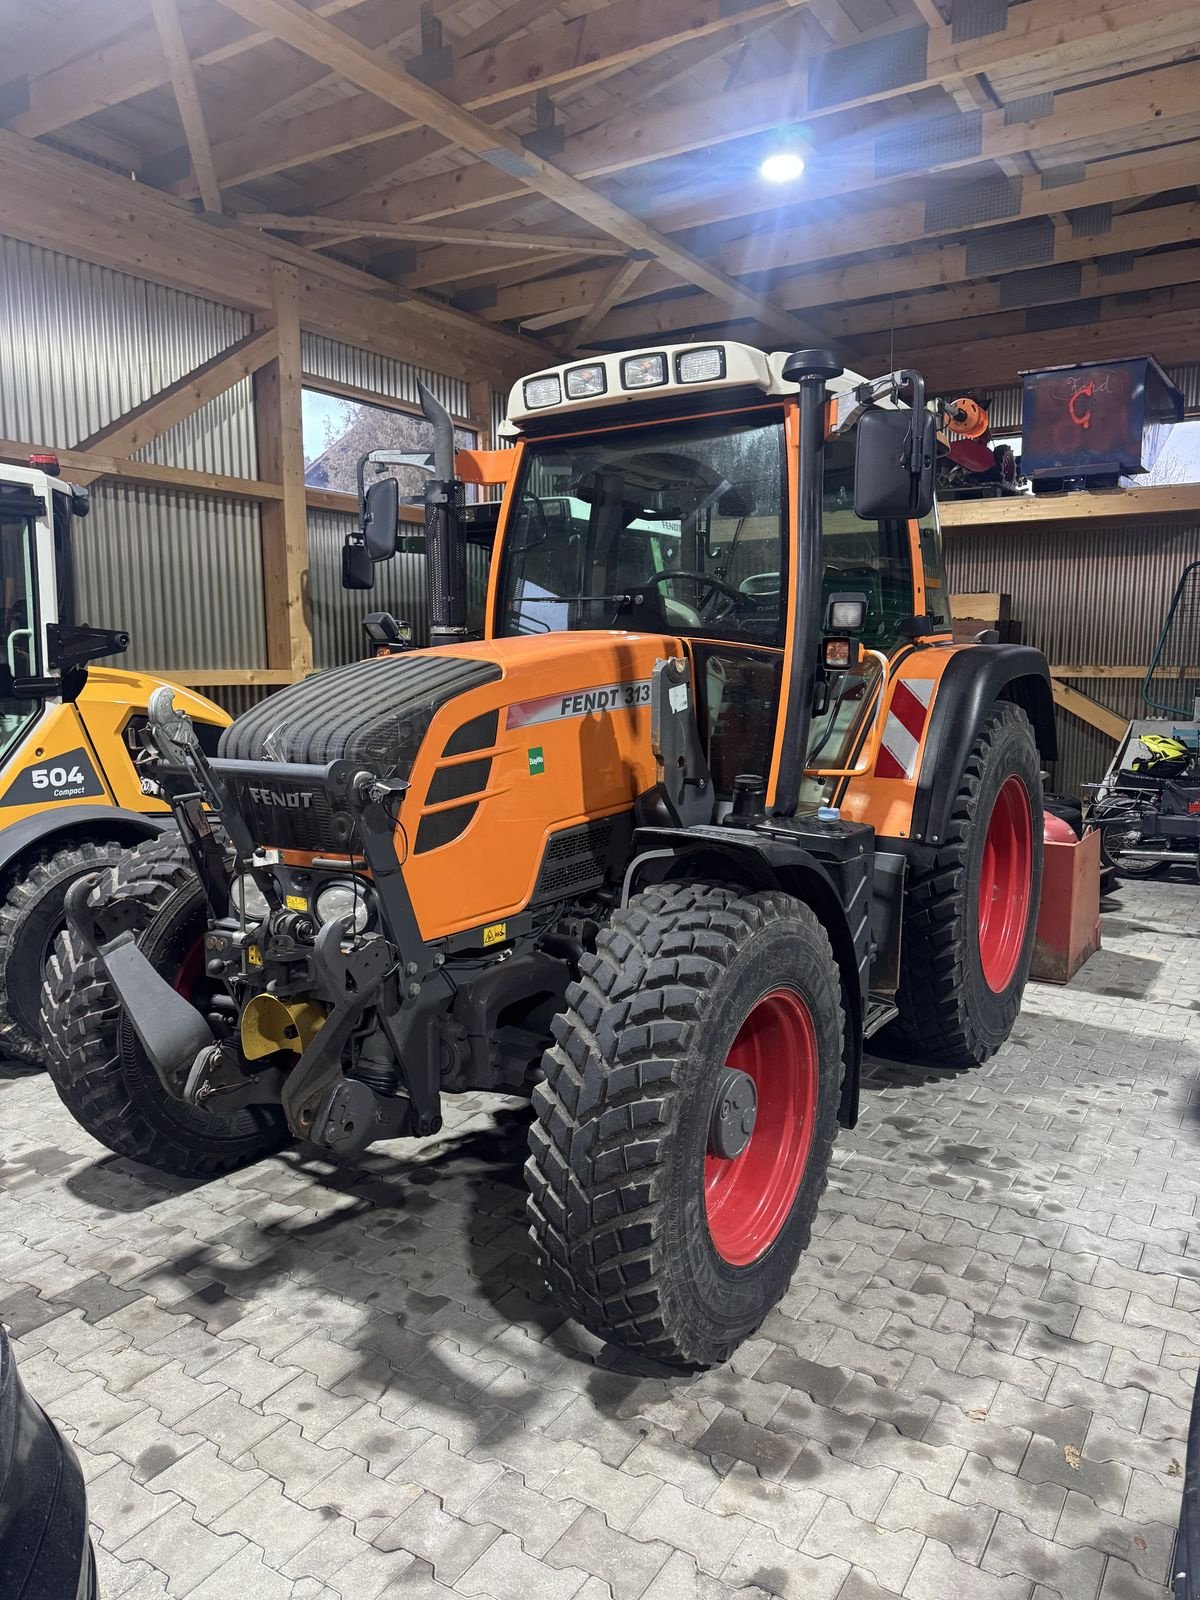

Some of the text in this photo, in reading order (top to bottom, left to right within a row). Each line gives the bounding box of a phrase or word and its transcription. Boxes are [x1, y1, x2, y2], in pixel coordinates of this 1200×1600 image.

[560, 684, 650, 716] FENDT 313
[31, 765, 85, 789] 504
[53, 786, 85, 797] Compact
[248, 787, 314, 808] FENDT
